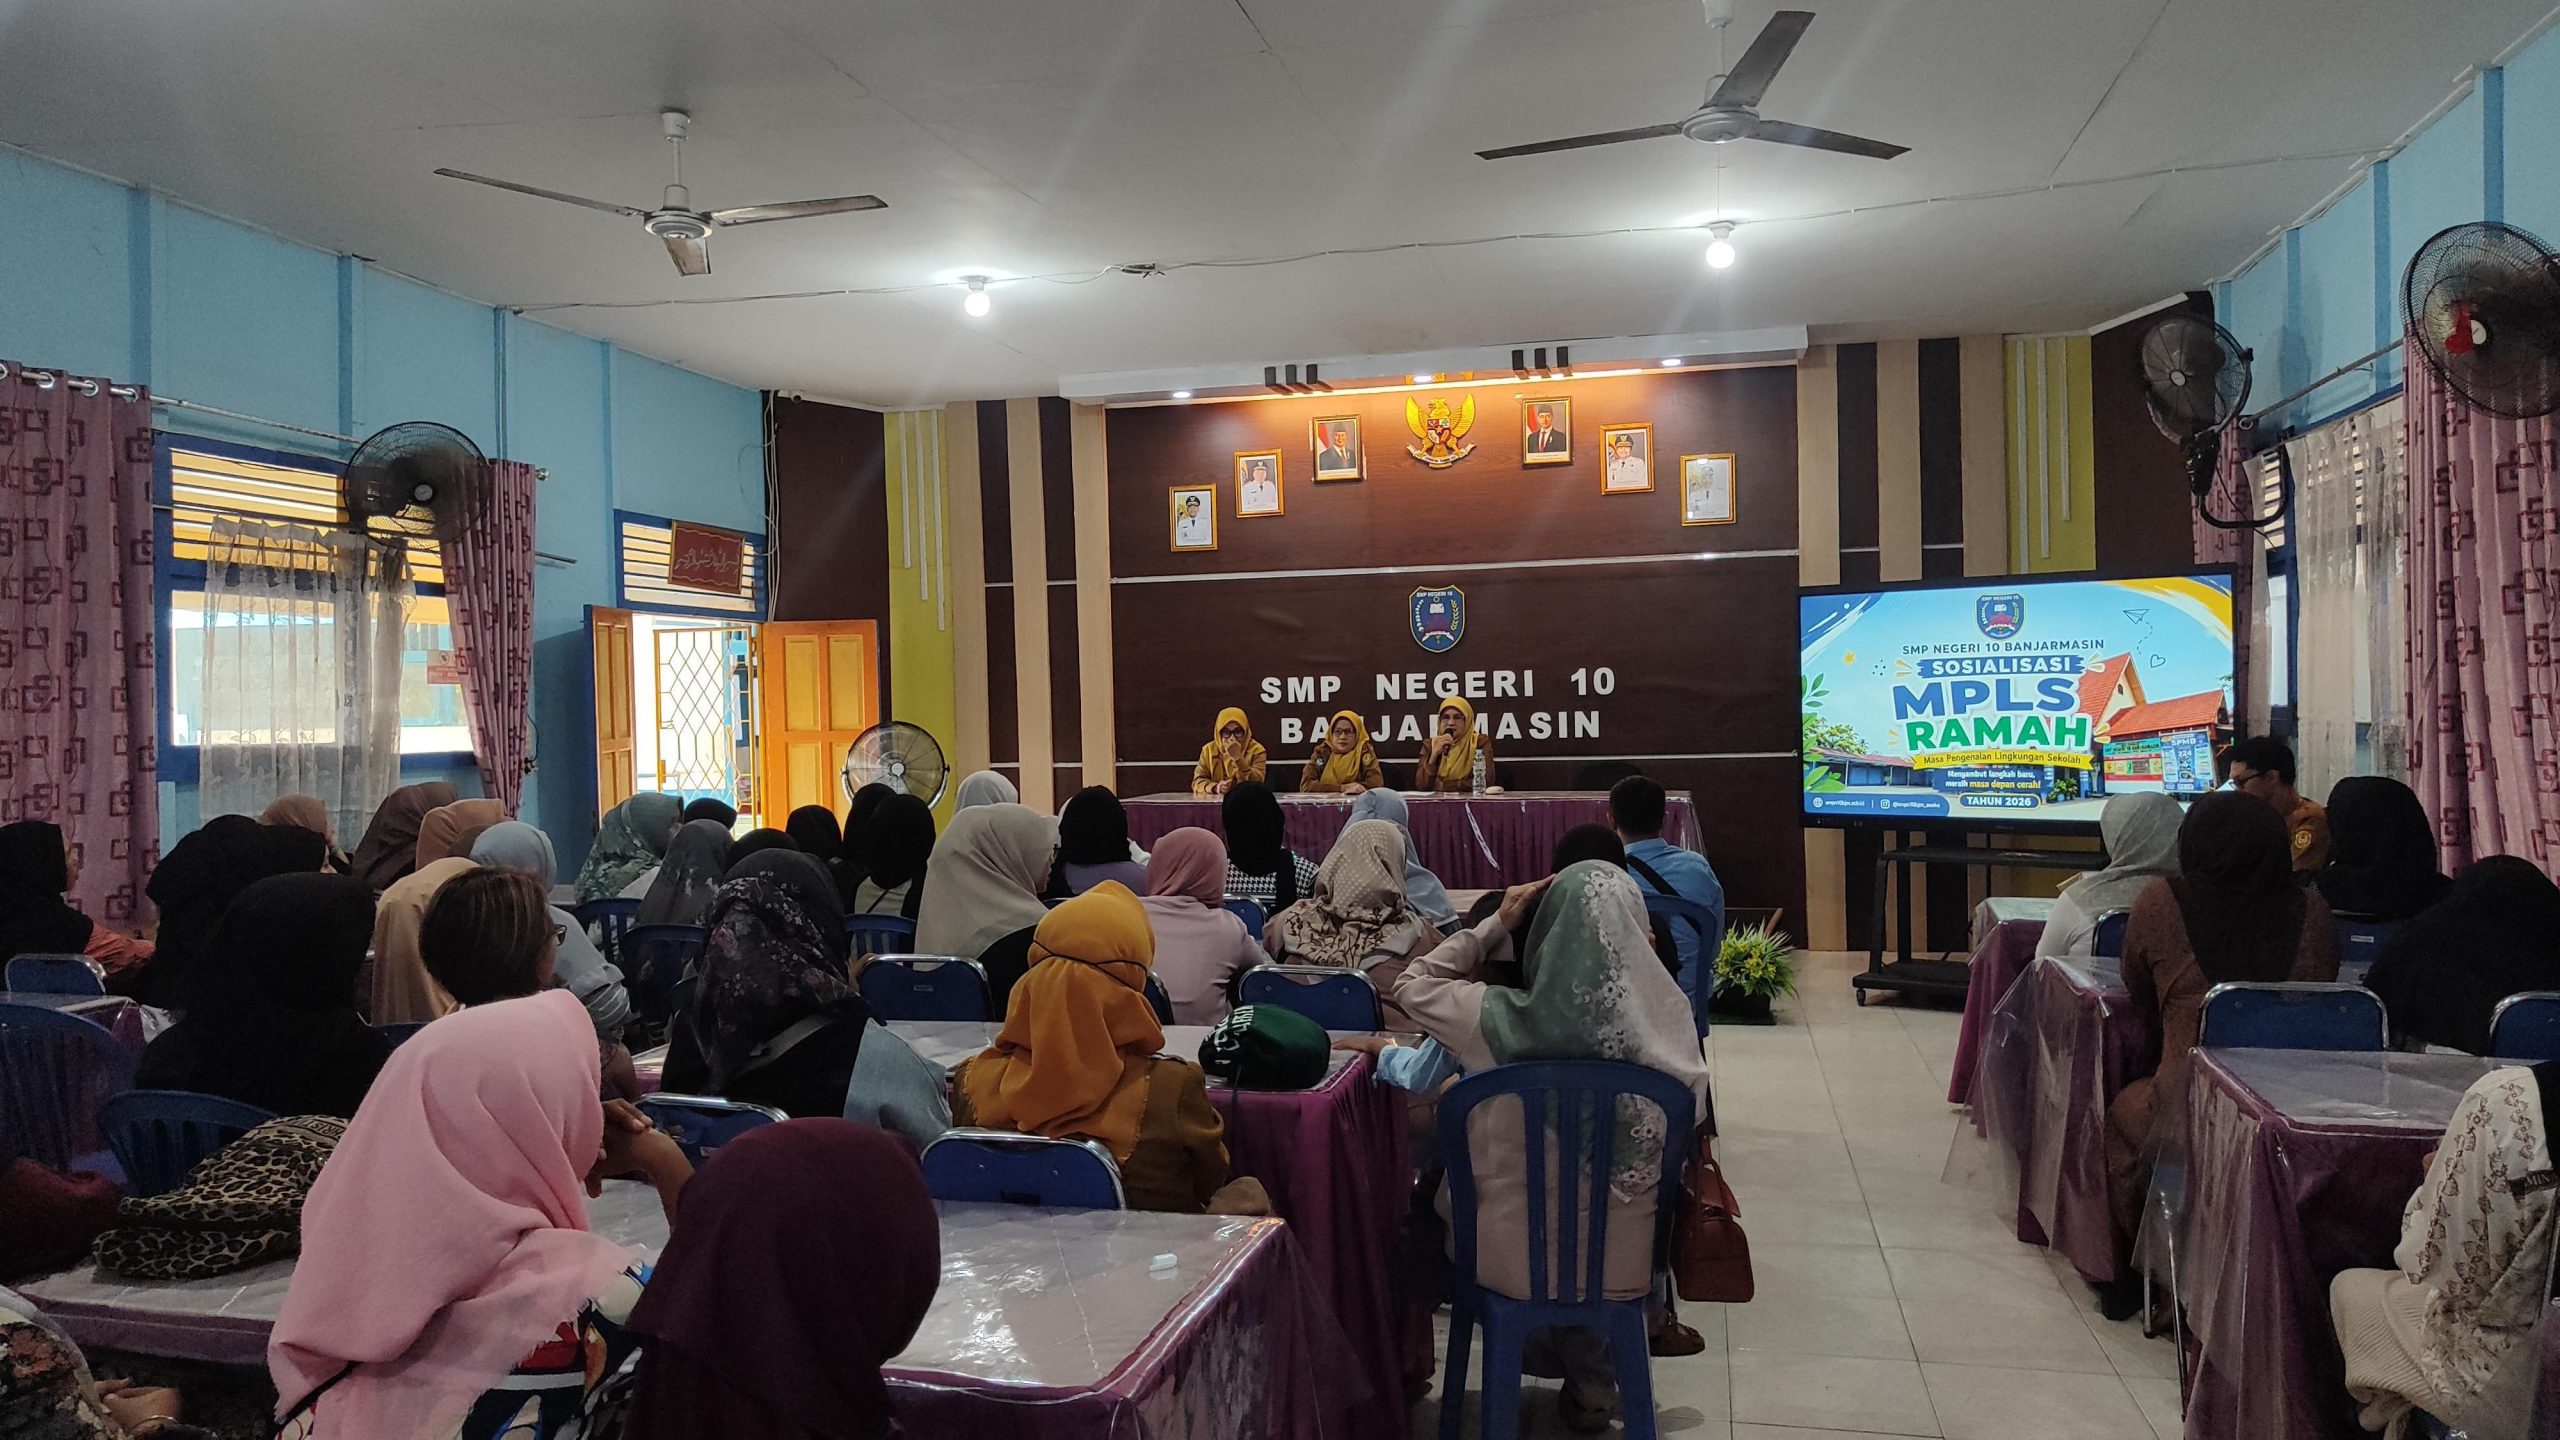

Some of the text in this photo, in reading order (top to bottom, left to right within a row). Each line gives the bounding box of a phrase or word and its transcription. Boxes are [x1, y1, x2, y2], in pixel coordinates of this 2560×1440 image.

[1902, 639, 2105, 655] SMP NEGERI 10 BANJARMASIN
[1932, 656, 2071, 675] SOSIALISASI
[1259, 666, 1616, 704] SMP NEGERI 10
[1892, 677, 2075, 721] MPLS
[1280, 710, 1600, 745] BAJAMASIN
[1906, 715, 2088, 751] RAMAH
[1923, 751, 2081, 764] Masa Pengenalan Lingkungan Sekolah
[1947, 769, 2036, 779] Menyambut langkah baru,
[1945, 780, 1968, 788] meraih
[1991, 780, 2015, 790] depan
[2016, 780, 2041, 789] cerah!
[1966, 796, 2032, 807] TAHUN 2026
